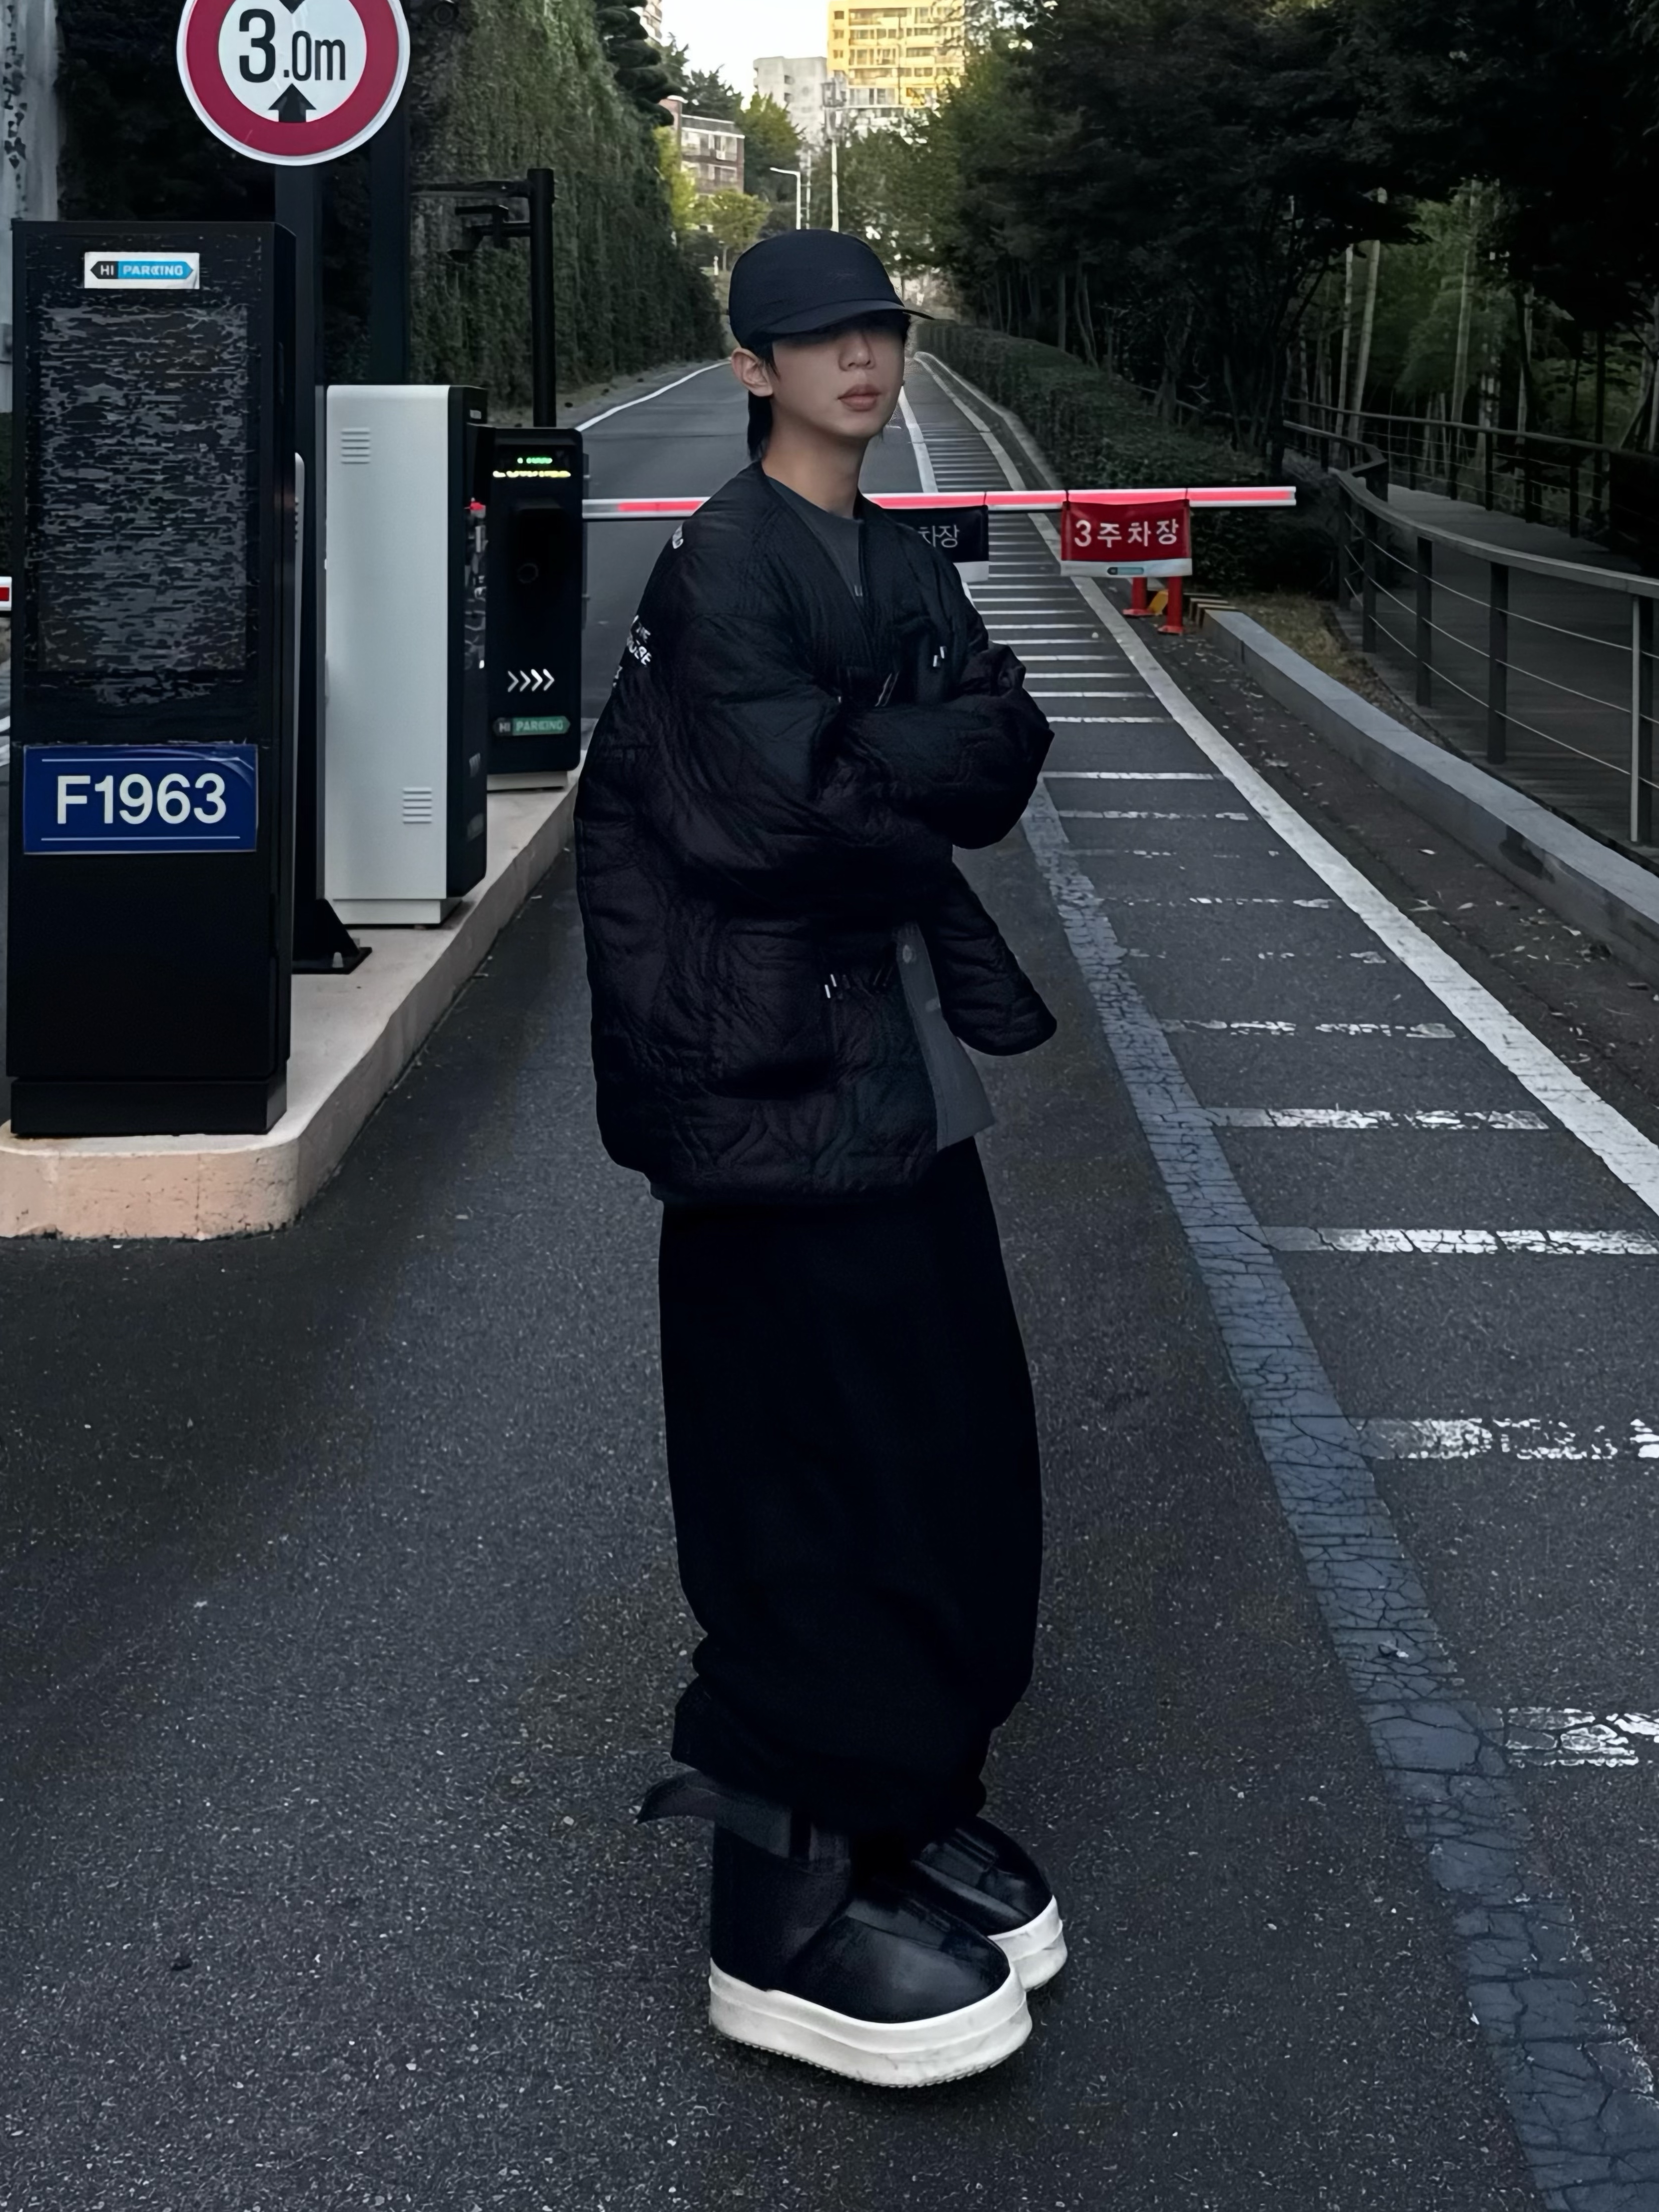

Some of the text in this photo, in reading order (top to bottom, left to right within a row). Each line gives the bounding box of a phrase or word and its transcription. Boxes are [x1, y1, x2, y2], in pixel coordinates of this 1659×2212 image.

[239, 8, 346, 83] 3.0m
[100, 264, 183, 276] HI PARKING
[917, 524, 960, 548] 차장
[1074, 519, 1179, 548] 3주차장
[57, 773, 226, 825] F1963
